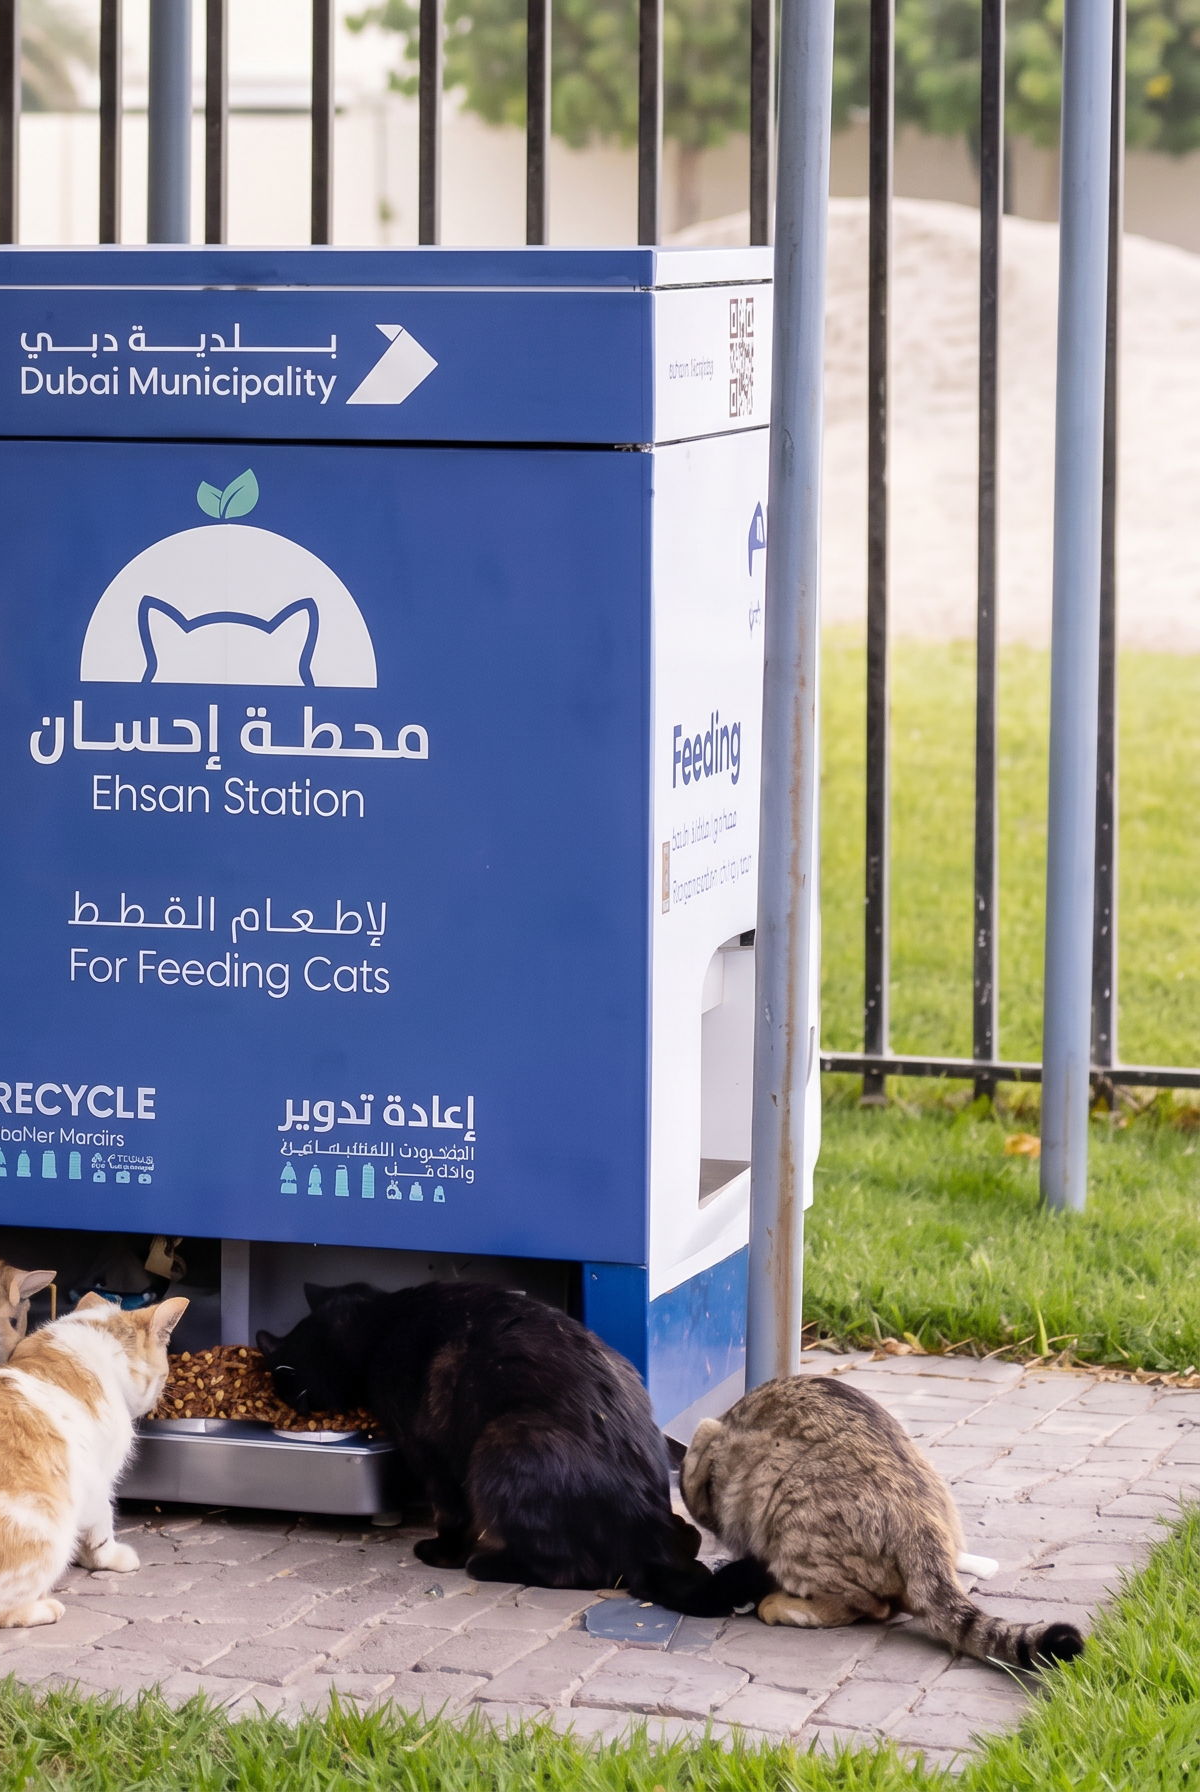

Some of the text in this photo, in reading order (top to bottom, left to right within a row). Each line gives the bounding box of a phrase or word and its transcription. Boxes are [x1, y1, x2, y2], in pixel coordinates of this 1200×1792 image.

[20, 322, 338, 360] بلدية دبي
[21, 365, 338, 405] Dubai Municipality
[29, 700, 430, 771] محطة إحسان
[672, 709, 741, 788] Feeding
[93, 774, 365, 818] Ehsan Station
[67, 890, 388, 947] لإطعام القطط
[70, 947, 390, 999] For Feeding Cats
[277, 1093, 477, 1142] إعادة تدوير
